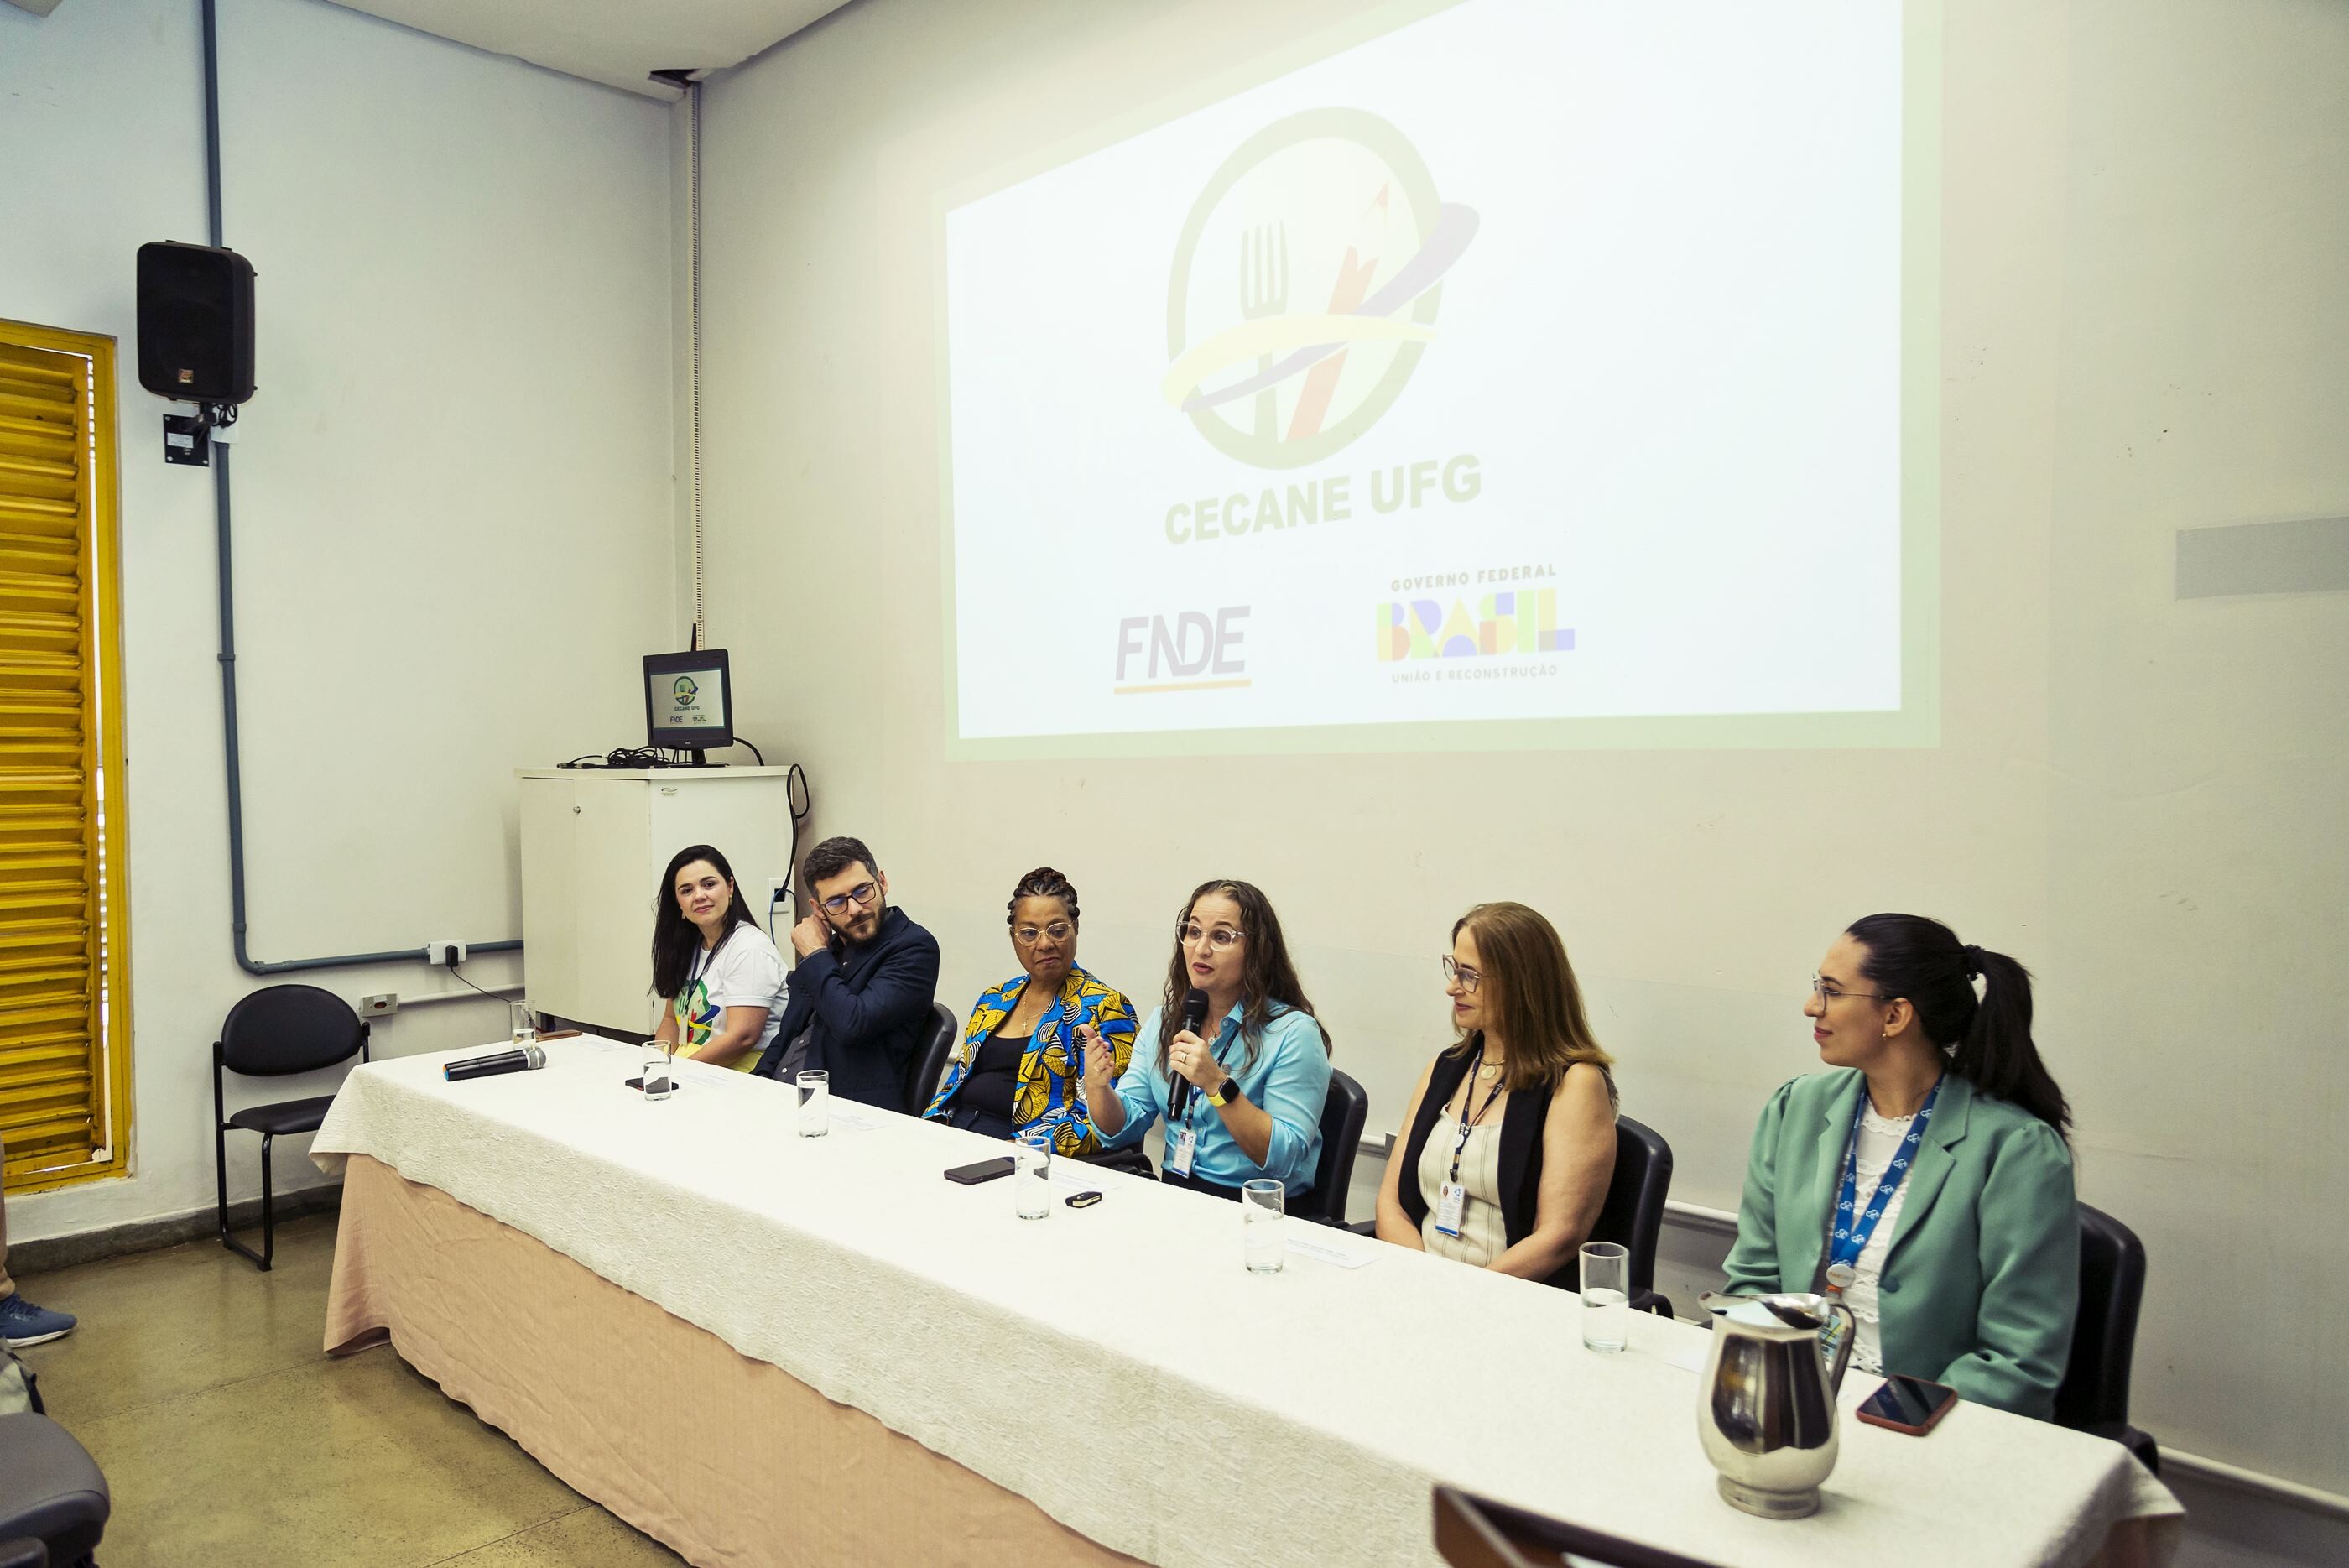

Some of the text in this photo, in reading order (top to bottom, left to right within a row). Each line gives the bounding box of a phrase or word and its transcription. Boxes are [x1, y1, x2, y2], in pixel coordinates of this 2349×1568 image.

[1164, 453, 1482, 545] CECANE UFG
[1390, 563, 1558, 593] GOVERNO FEDERAL
[1114, 604, 1252, 682] FNDE
[1376, 587, 1576, 663] BRASIL
[1391, 663, 1558, 684] UNIÃO E RECONSTRUÇÃO
